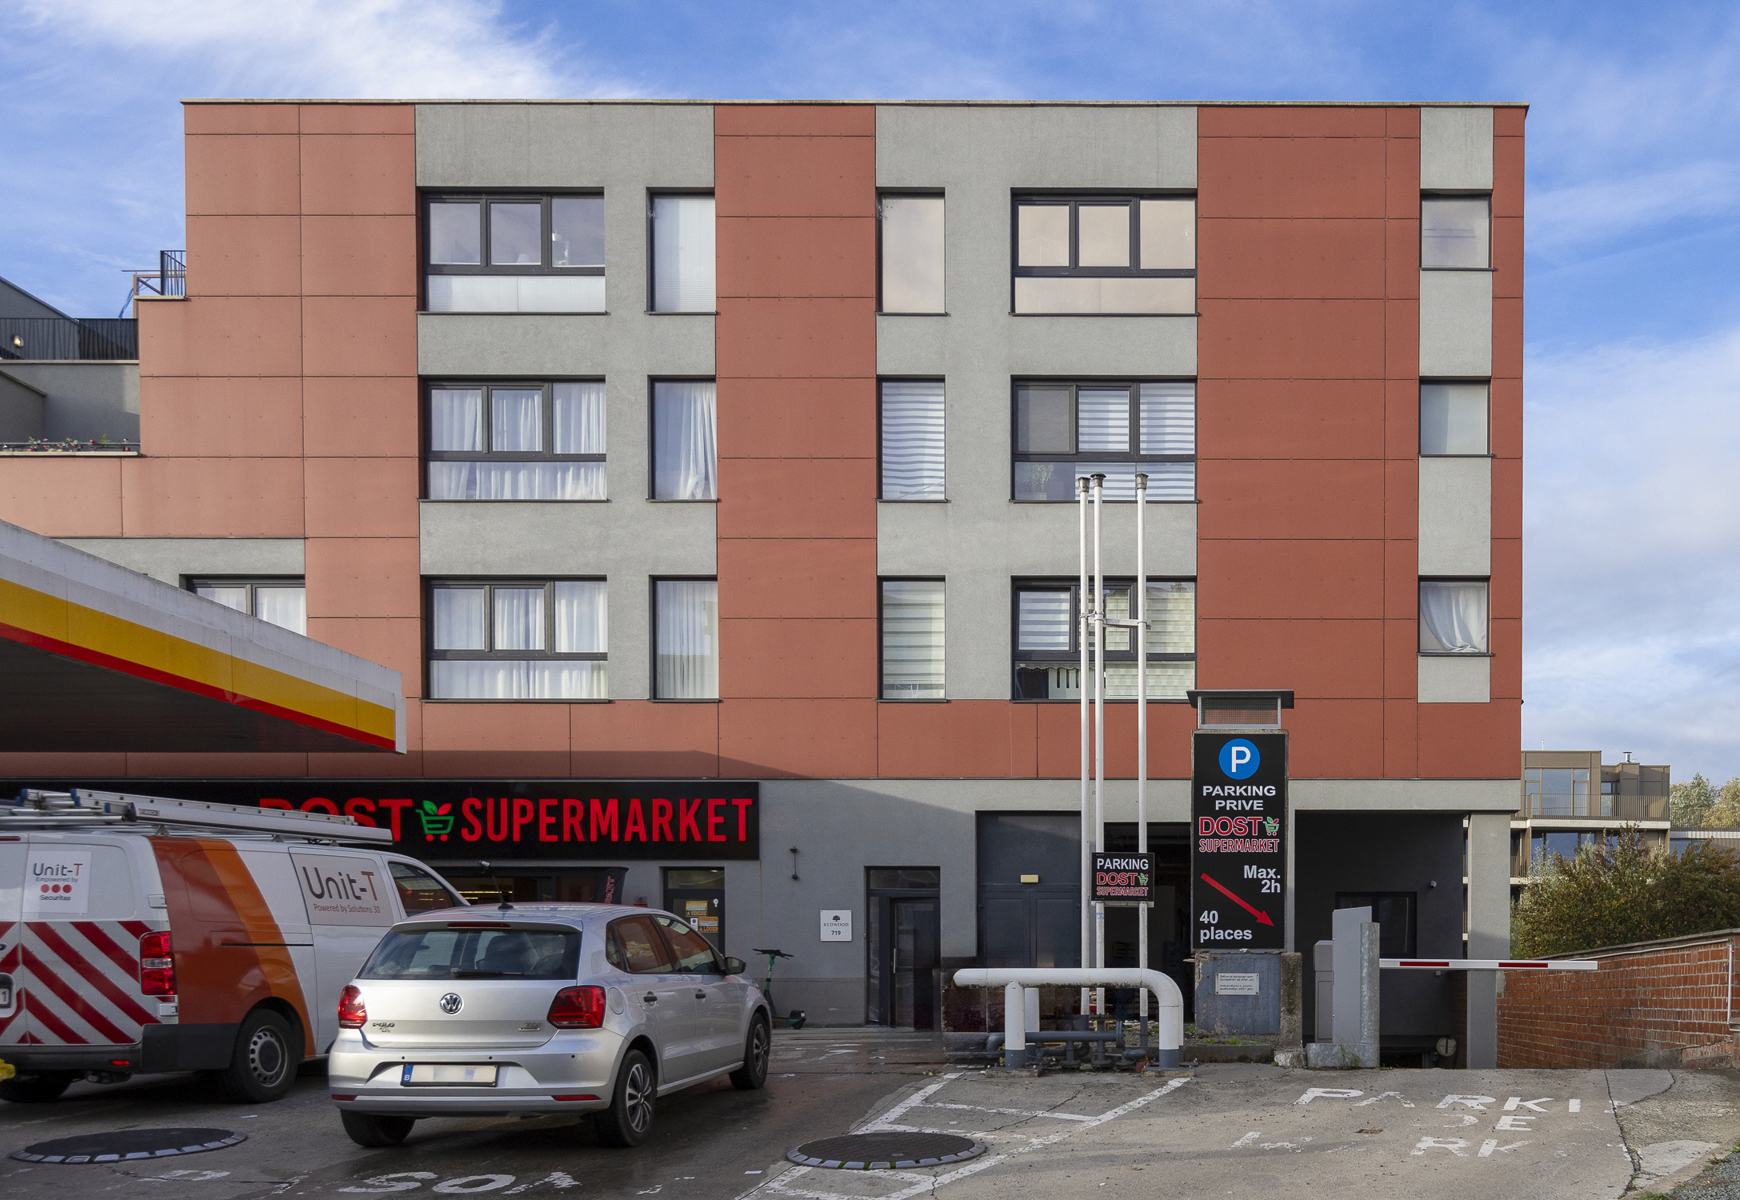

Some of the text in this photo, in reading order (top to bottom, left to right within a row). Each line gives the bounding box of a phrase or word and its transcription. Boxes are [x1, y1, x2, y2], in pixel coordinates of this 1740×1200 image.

[1231, 746, 1252, 773] P
[1202, 785, 1276, 797] PARKING
[1215, 800, 1264, 811] PRIVE
[460, 797, 753, 842] SUPERMARKET
[1199, 816, 1264, 836] DOST
[1199, 839, 1280, 853] SUPERMARKET
[33, 862, 84, 876] Unit-T
[1096, 858, 1149, 870] PARKING
[1096, 871, 1138, 886] DOST
[1243, 865, 1281, 879] Max.
[302, 866, 378, 901] Unit-T
[1261, 879, 1281, 893] 2h
[1096, 886, 1149, 897] SUPERMARKET
[313, 903, 381, 914] Powered by Solutions 30
[1199, 910, 1219, 924] 40
[1200, 926, 1252, 943] places
